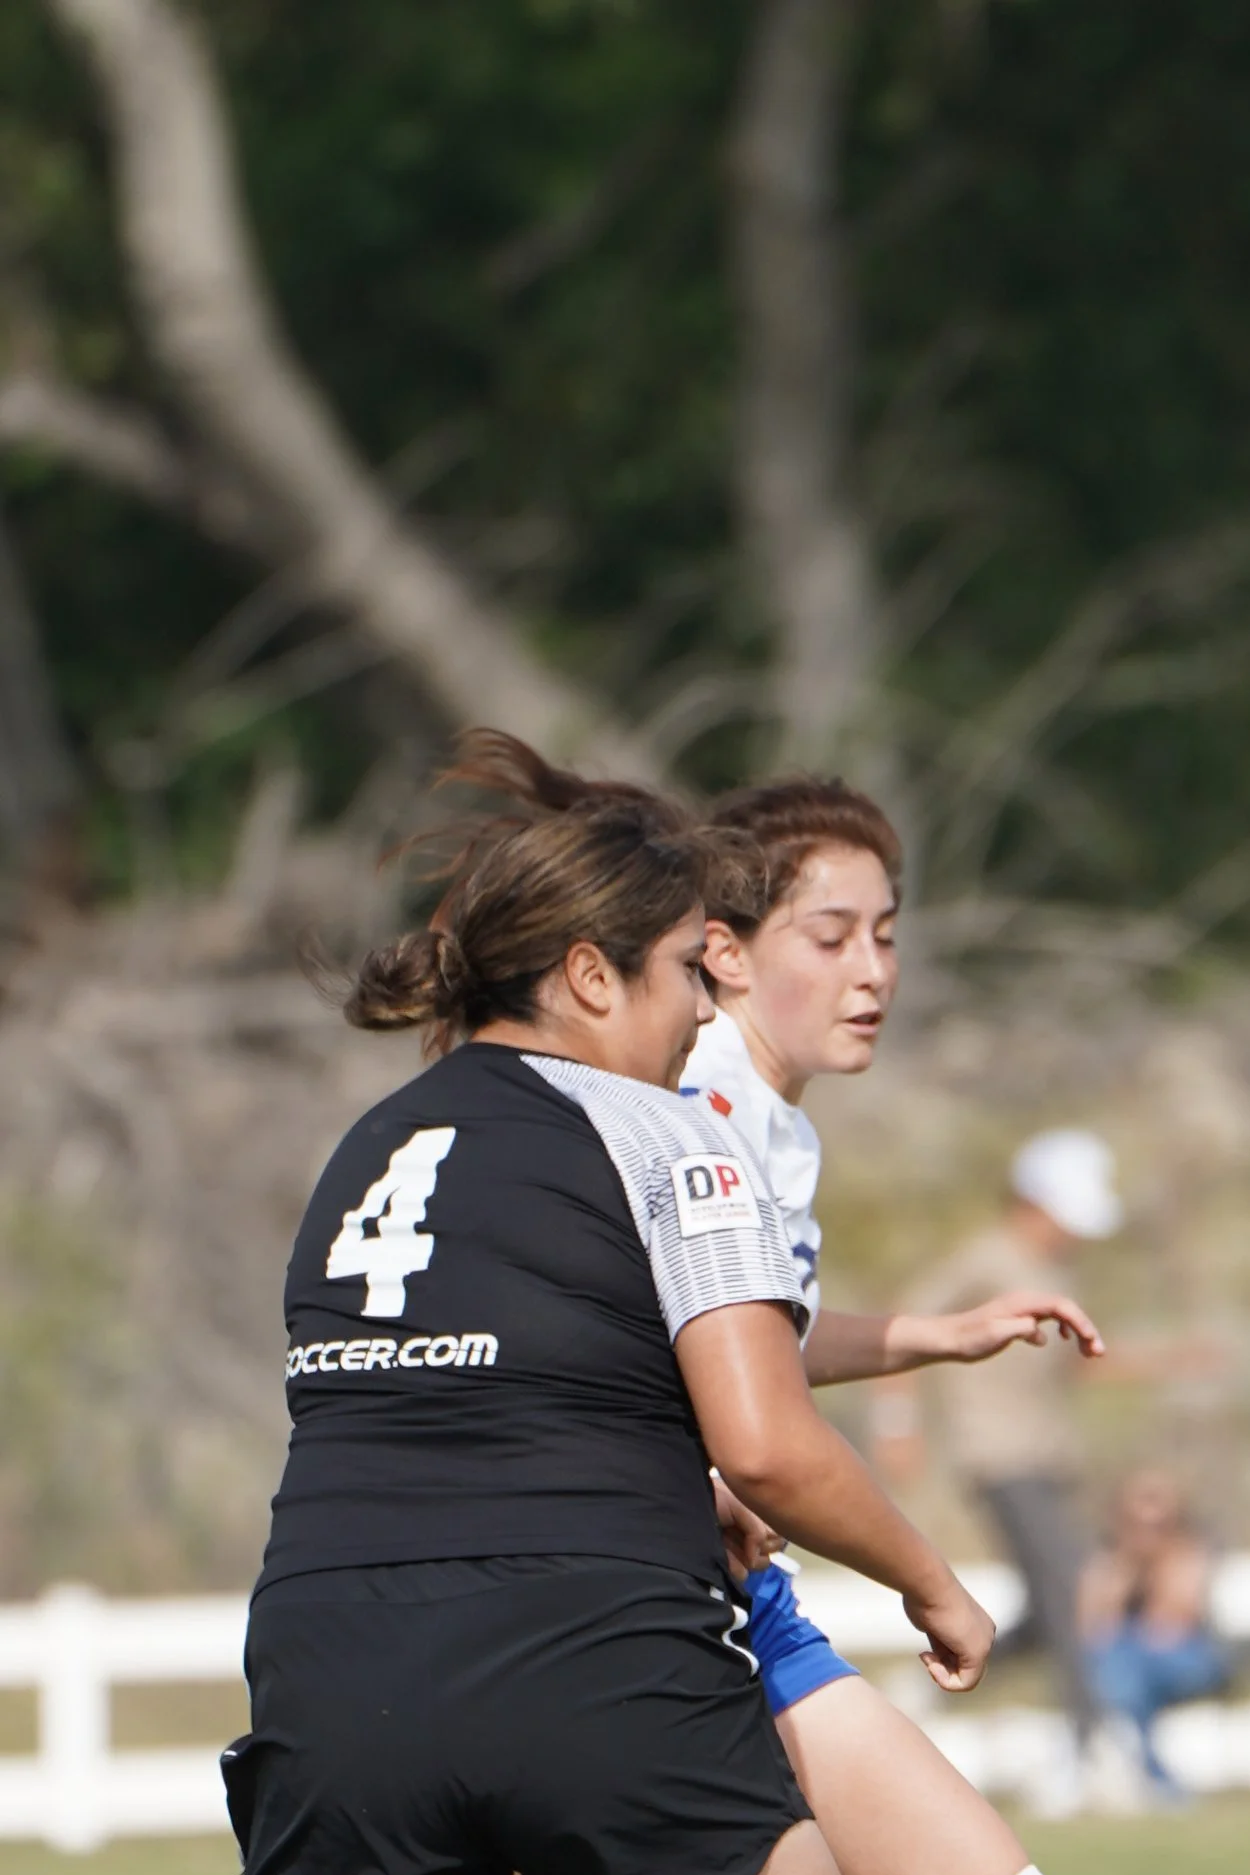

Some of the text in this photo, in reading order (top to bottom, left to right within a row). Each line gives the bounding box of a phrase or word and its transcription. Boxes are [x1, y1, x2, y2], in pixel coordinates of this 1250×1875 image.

[684, 1165, 740, 1200] DP
[325, 1127, 457, 1318] 4
[285, 1333, 499, 1381] OCCER.COM
